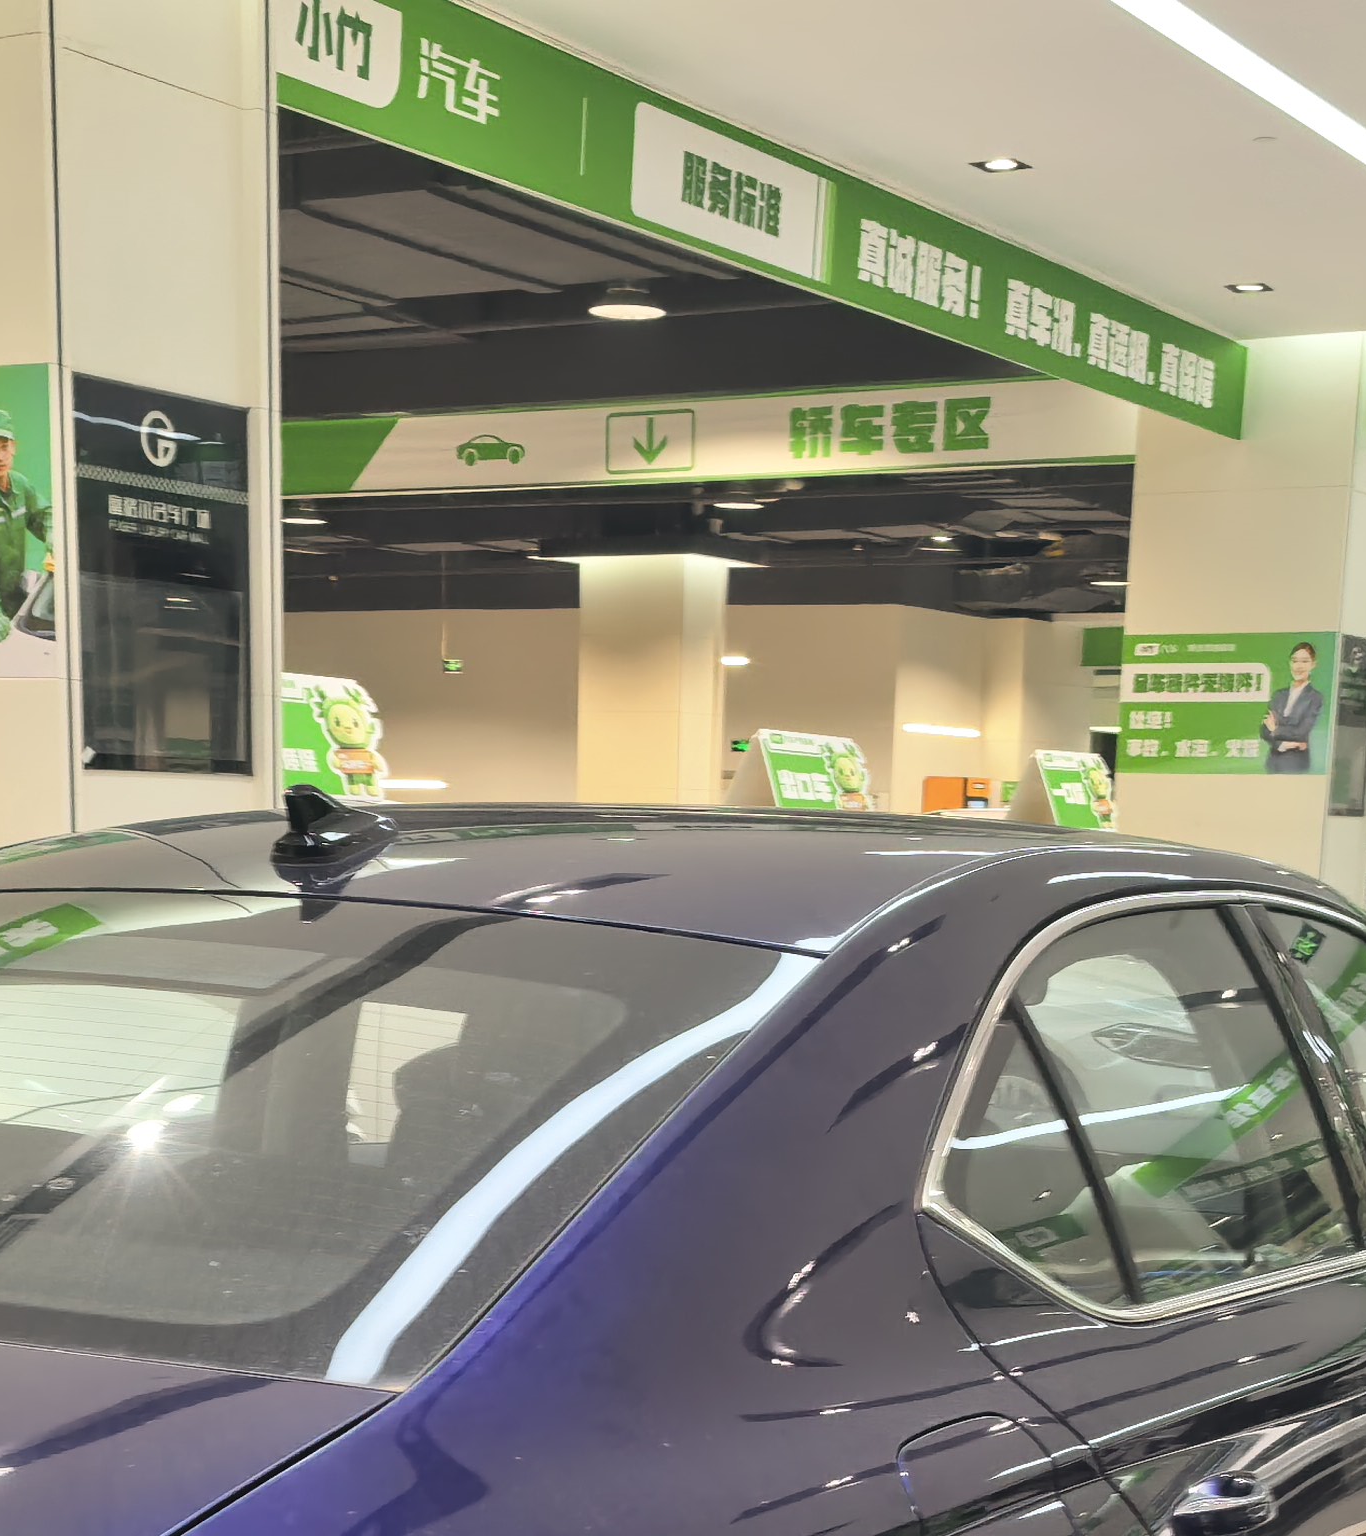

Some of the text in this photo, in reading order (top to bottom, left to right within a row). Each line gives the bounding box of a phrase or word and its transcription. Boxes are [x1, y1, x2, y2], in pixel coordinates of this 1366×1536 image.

[295, 0, 502, 124] 小竹 汽车
[681, 150, 783, 238] 服务标准
[789, 396, 991, 460] 轿车专区
